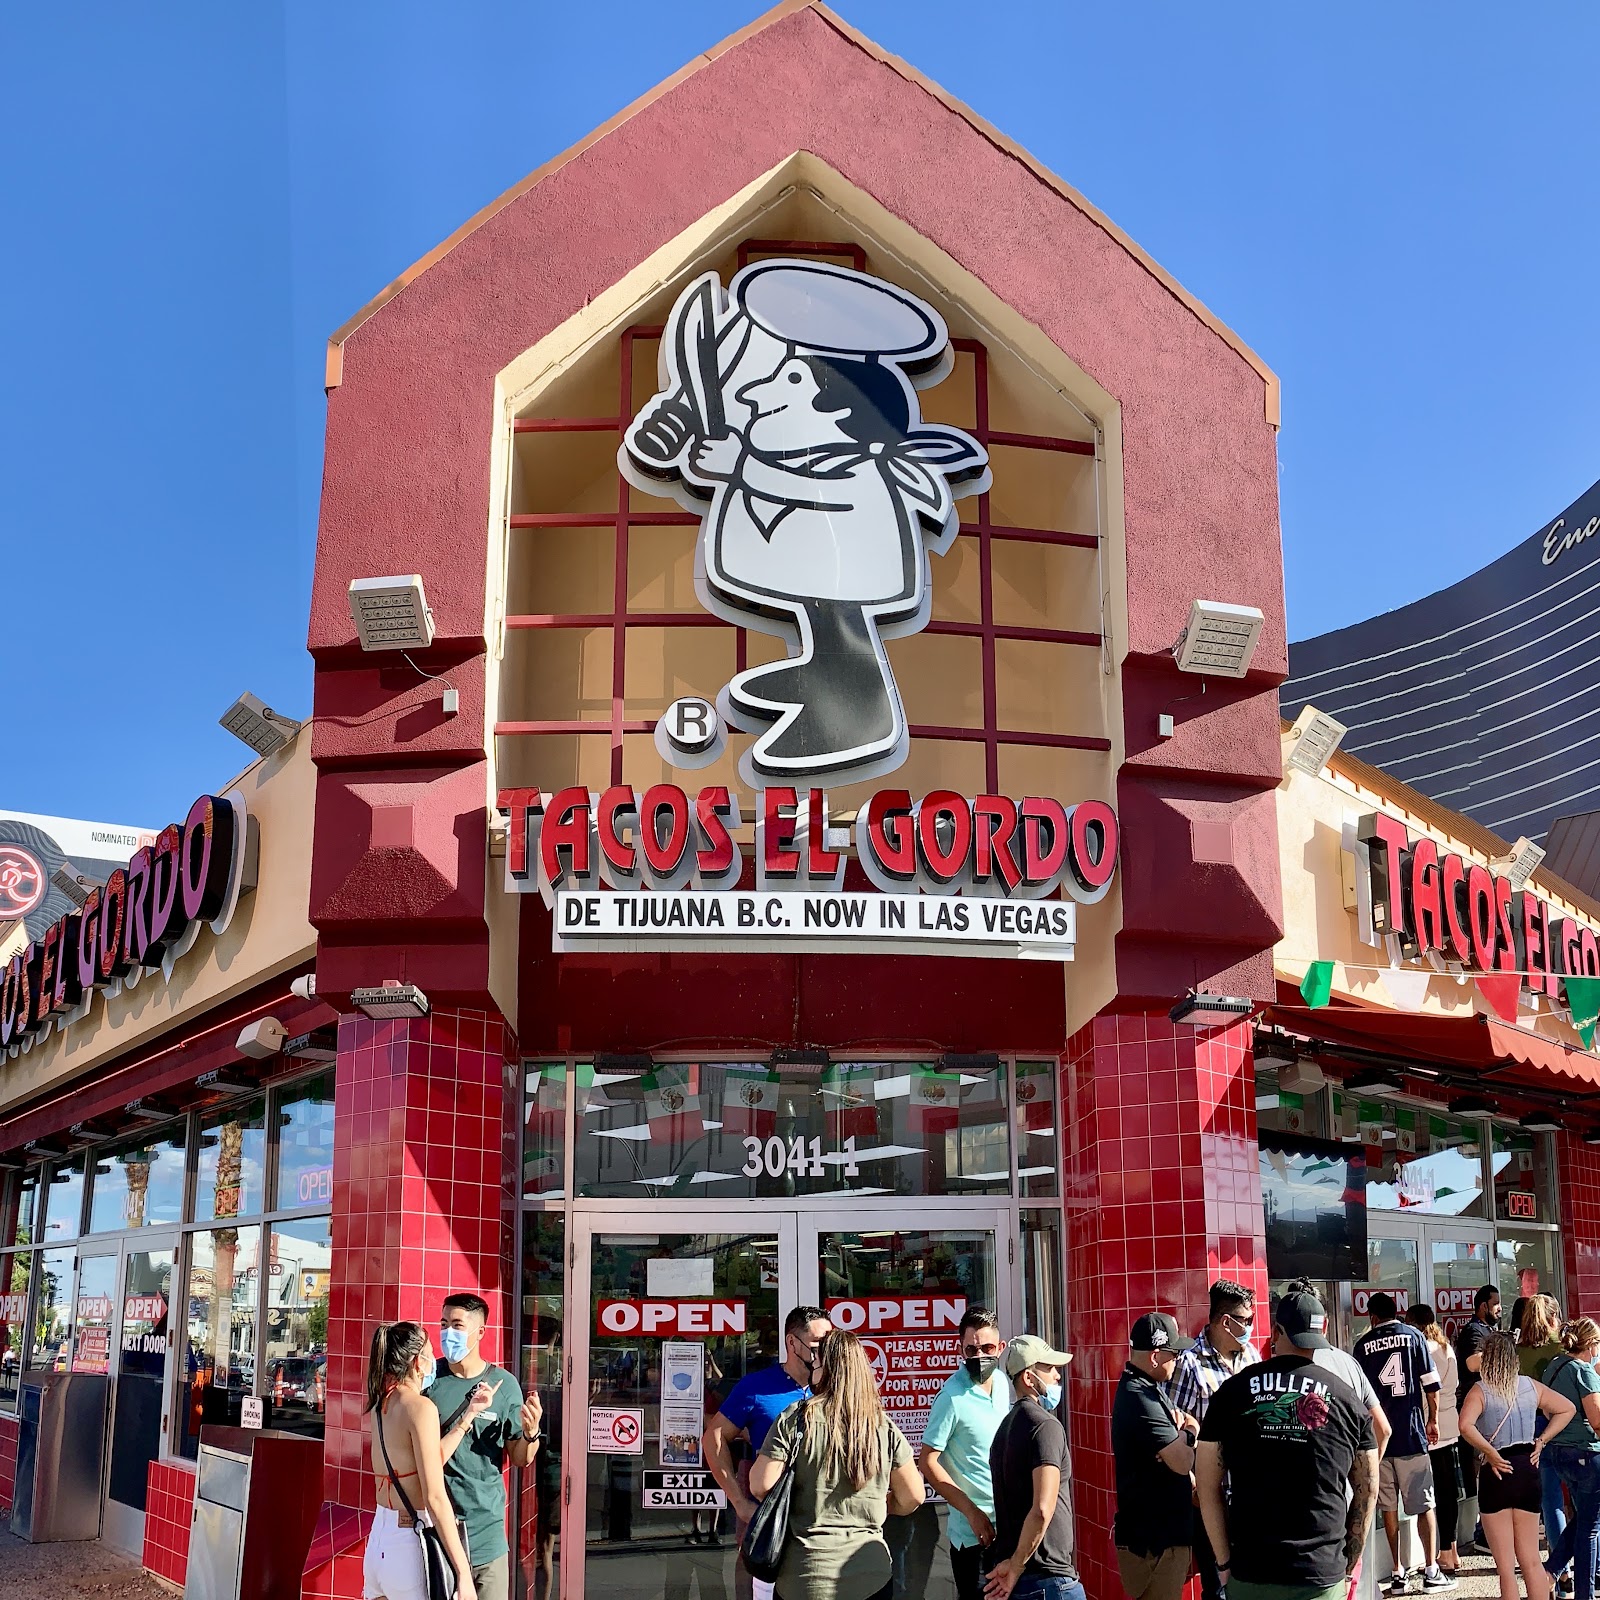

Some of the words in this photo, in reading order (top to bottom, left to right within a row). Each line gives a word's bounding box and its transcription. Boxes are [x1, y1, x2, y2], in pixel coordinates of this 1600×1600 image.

[91, 831, 137, 846] NOMINATED
[496, 783, 734, 888] TACOS
[764, 786, 840, 877] EL
[868, 789, 1120, 892] GORDO
[1374, 811, 1517, 973] TACOS
[1523, 890, 1560, 1000] EL
[0, 942, 40, 1047] OS
[38, 914, 70, 1020] EL
[79, 794, 222, 989] GORDO
[565, 898, 601, 926] DE
[613, 898, 724, 927] TIJUANA
[737, 898, 791, 927] B.C.
[804, 899, 867, 928] NOW
[879, 900, 906, 929] IN
[918, 901, 970, 931] LAS
[981, 904, 1068, 936] VEGAS
[741, 1135, 859, 1178] 3041-1
[216, 1186, 246, 1214] OPEN
[1510, 1194, 1535, 1216] OPEN
[78, 1298, 108, 1317] OPEN
[126, 1298, 162, 1319] OPEN
[1355, 1291, 1409, 1314] ON
[601, 1303, 745, 1332] OPEN
[830, 1298, 966, 1331] OPEN
[121, 1333, 142, 1352] NEXT
[143, 1334, 166, 1354] DOOR
[885, 1340, 932, 1353] PLEASE
[1363, 1334, 1412, 1356] PRESCOTT
[891, 1355, 922, 1368] FACE
[885, 1379, 910, 1391] POR
[1250, 1372, 1329, 1397] SULLEN
[1378, 1351, 1407, 1397] 4
[662, 1473, 707, 1488] EXIT
[651, 1491, 718, 1505] SALIDA
